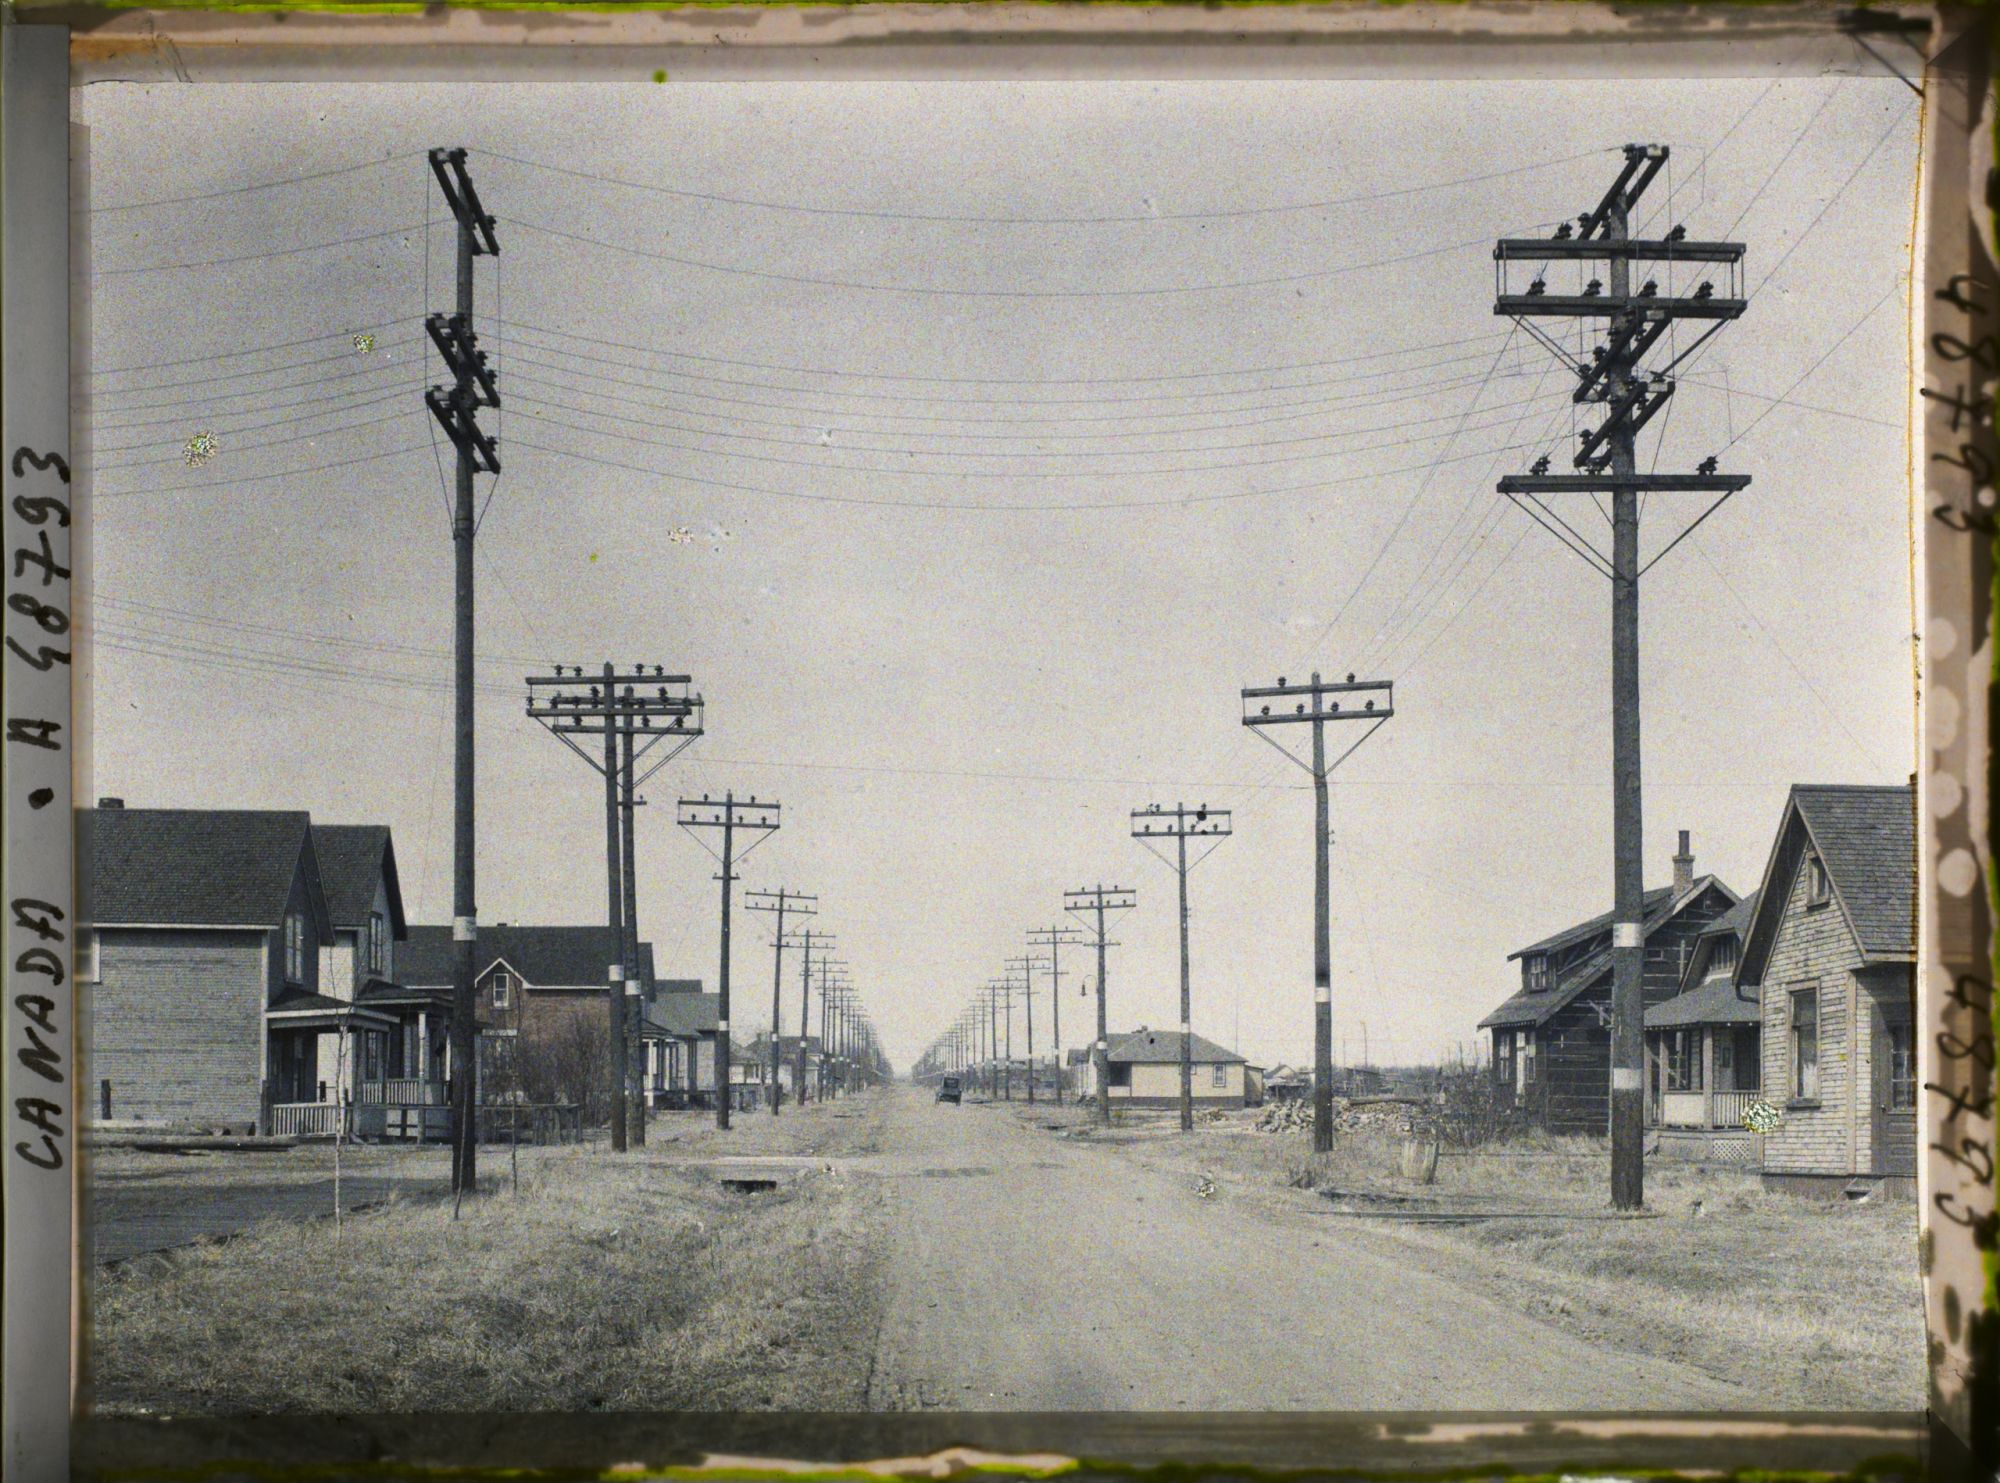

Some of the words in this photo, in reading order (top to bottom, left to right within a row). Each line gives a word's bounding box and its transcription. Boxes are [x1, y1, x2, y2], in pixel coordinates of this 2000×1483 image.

[1920, 273, 1997, 536] 48793
[7, 717, 62, 751] A
[11, 898, 65, 1170] CANADA
